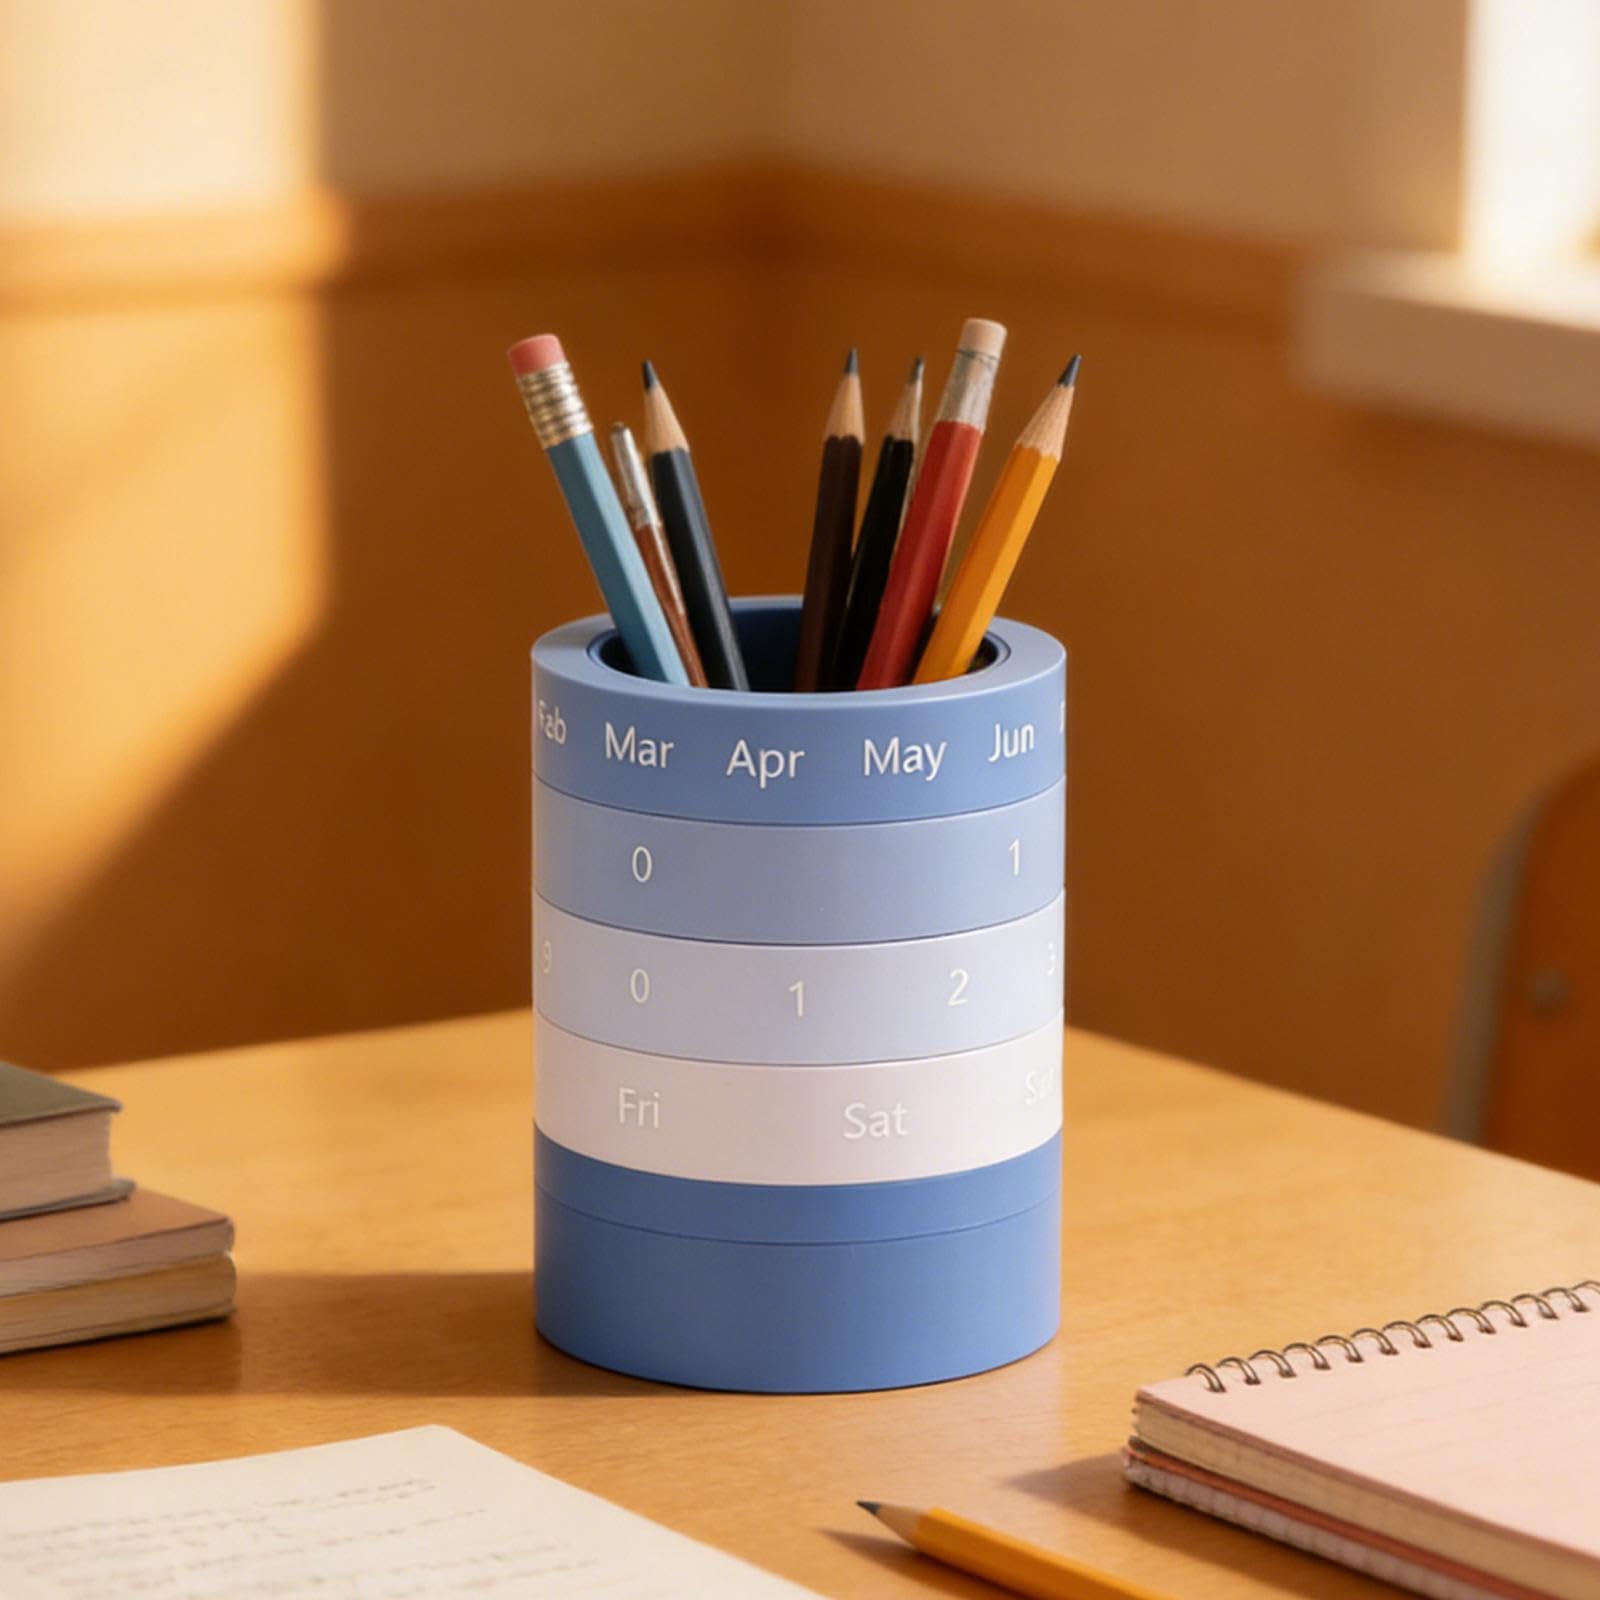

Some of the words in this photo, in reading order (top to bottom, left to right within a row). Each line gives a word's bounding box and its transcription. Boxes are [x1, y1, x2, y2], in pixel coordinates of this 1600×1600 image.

[604, 721, 675, 768] Mar
[725, 739, 806, 789] Apr
[863, 736, 948, 782] May
[988, 723, 1036, 763] Jun
[632, 846, 653, 882] 0
[1008, 838, 1021, 876] 1
[630, 968, 650, 1004] 0
[788, 981, 806, 1016] 1
[948, 968, 970, 1007] 2
[617, 1086, 662, 1129] Fri
[843, 1102, 909, 1141] Sat
